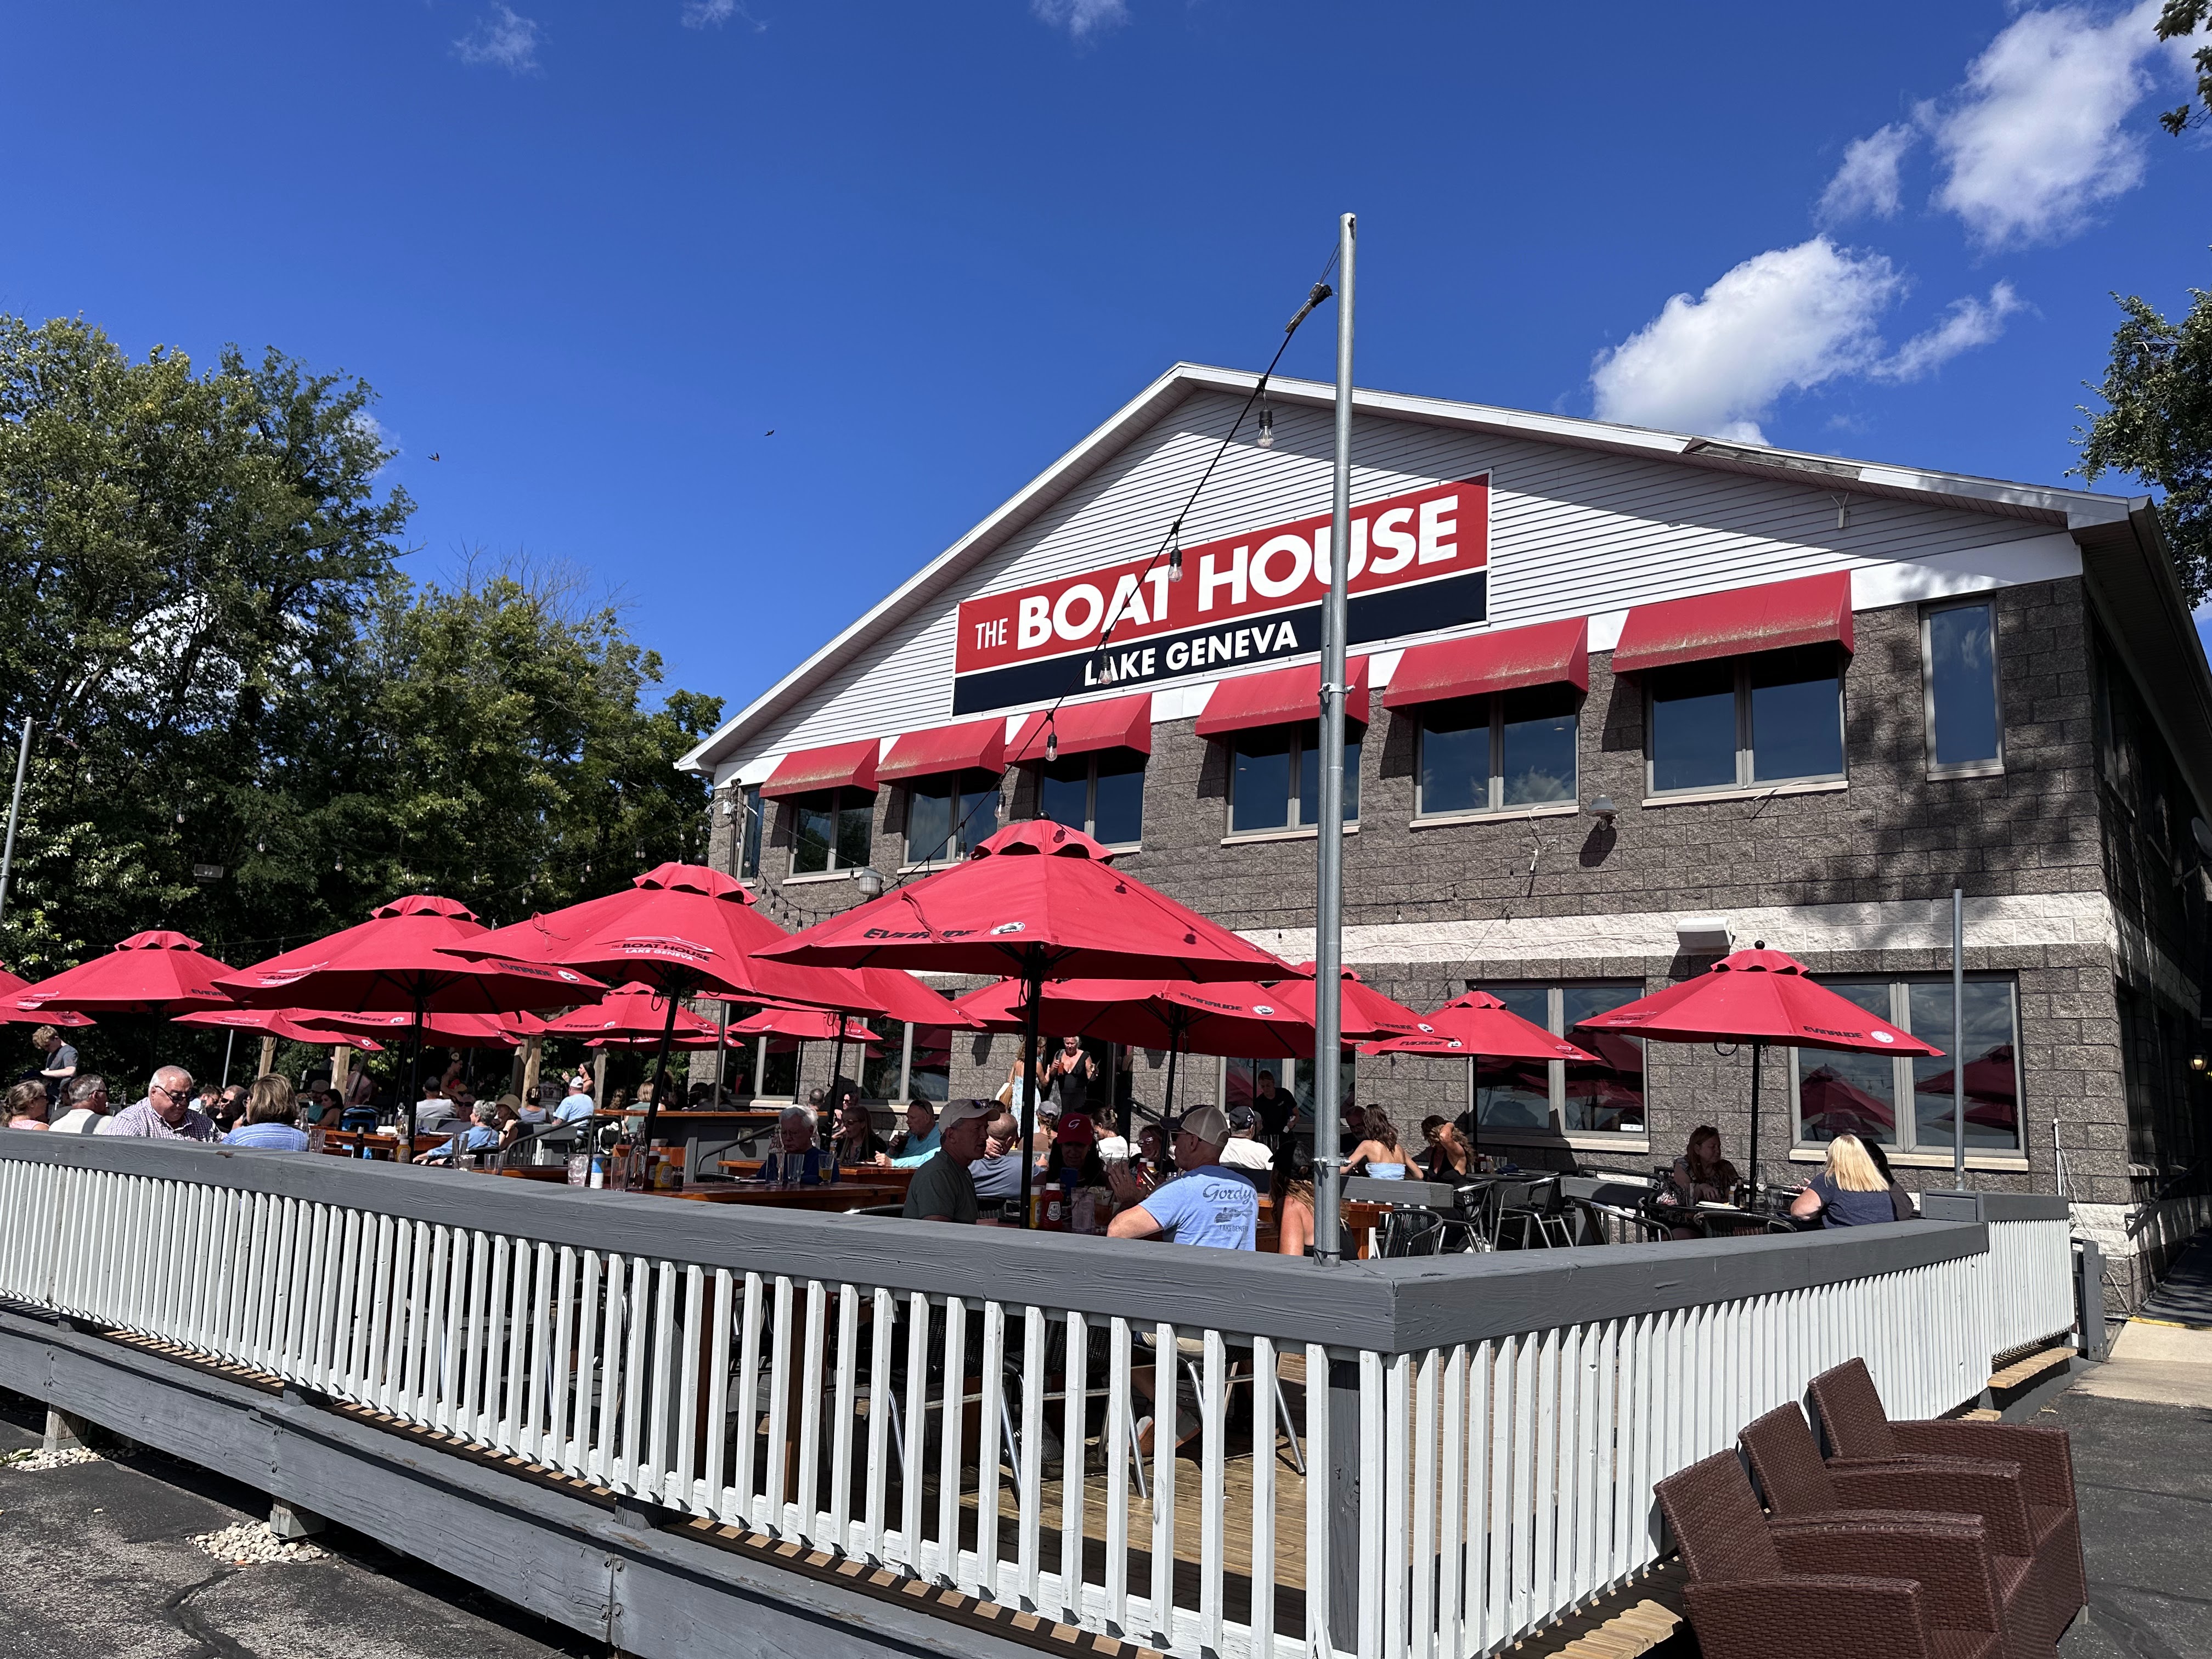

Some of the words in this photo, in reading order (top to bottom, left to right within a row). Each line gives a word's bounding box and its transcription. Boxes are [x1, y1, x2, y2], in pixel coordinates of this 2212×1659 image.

[975, 617, 1008, 650] THE
[1017, 564, 1172, 650] BOAT
[1198, 494, 1458, 612] HOUSE
[1084, 647, 1155, 686] LAKE
[1166, 620, 1299, 670] GENEVA
[653, 950, 693, 961] GENEVA
[663, 945, 710, 962] HOUSE
[1803, 1025, 1864, 1039] EVINRUDE
